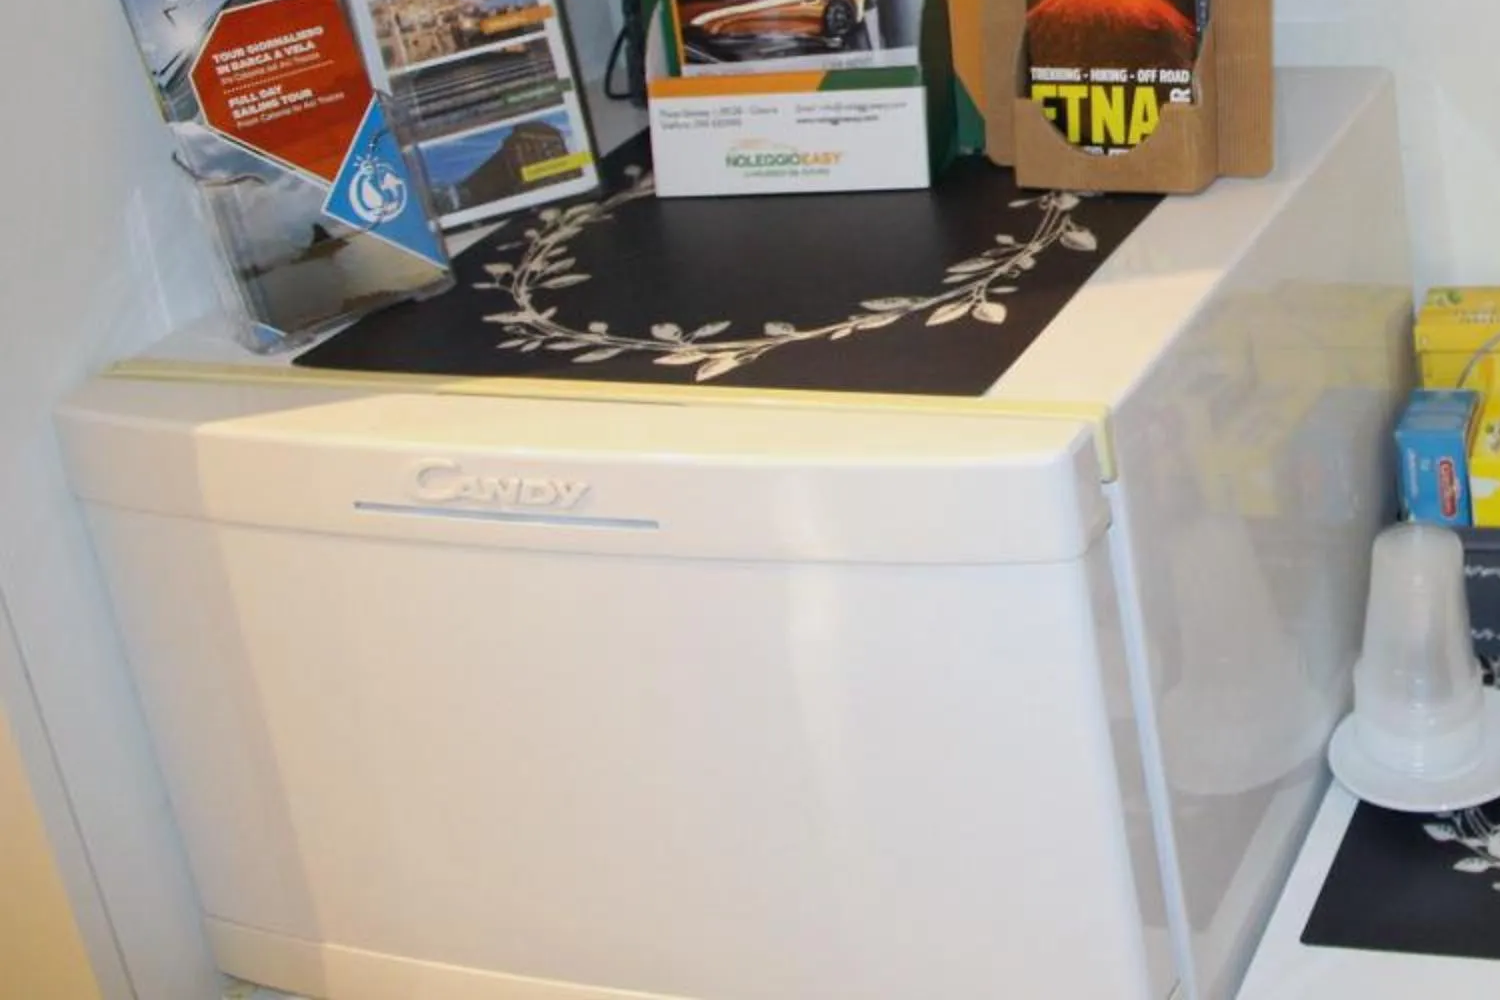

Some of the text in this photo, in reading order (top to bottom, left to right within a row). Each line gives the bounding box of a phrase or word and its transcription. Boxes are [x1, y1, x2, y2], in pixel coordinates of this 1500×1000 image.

[212, 47, 245, 64] TOUR
[273, 49, 283, 60] A
[284, 40, 317, 55] VELA
[1137, 70, 1157, 82] OFF
[1159, 70, 1190, 83] ROAD
[280, 87, 313, 104] TOUR
